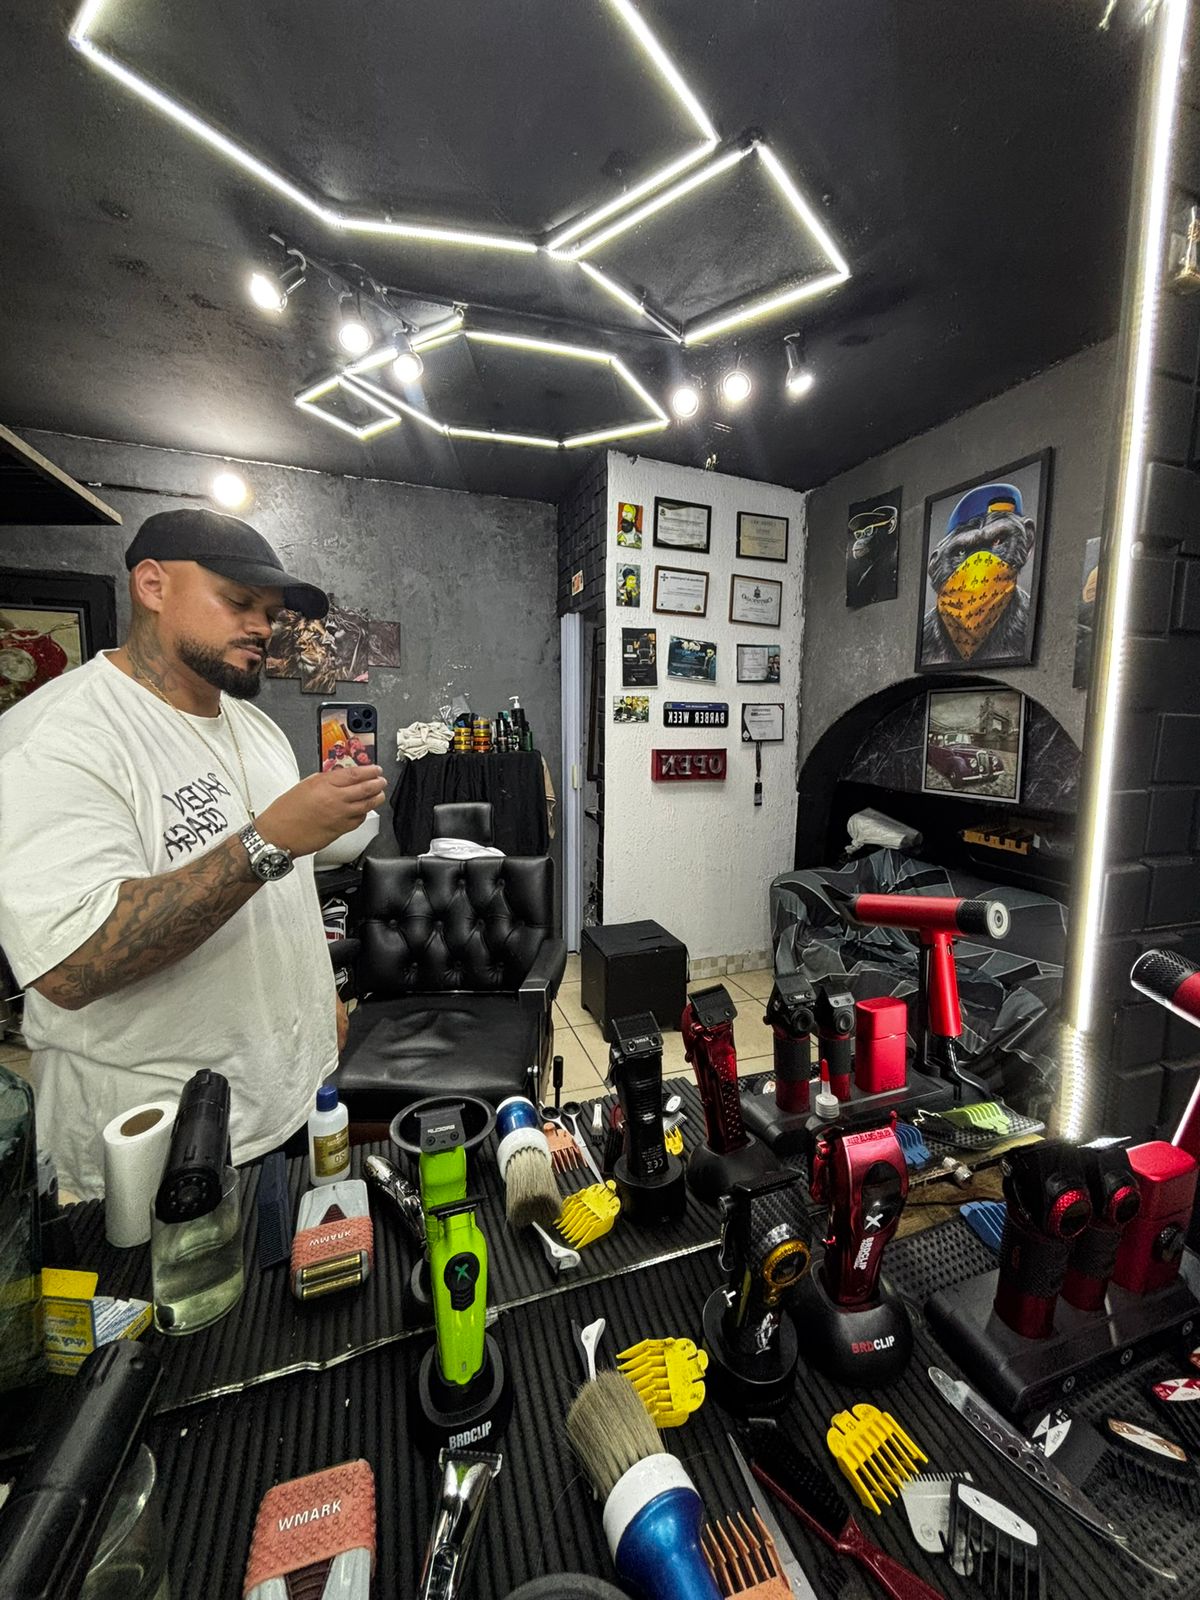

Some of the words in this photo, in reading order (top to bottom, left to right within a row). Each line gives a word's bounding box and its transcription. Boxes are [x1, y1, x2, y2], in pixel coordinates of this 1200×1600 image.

[851, 1334, 895, 1355] BRDCLIP
[448, 1420, 493, 1450] BRDCLIP
[277, 1499, 343, 1532] WMARK
